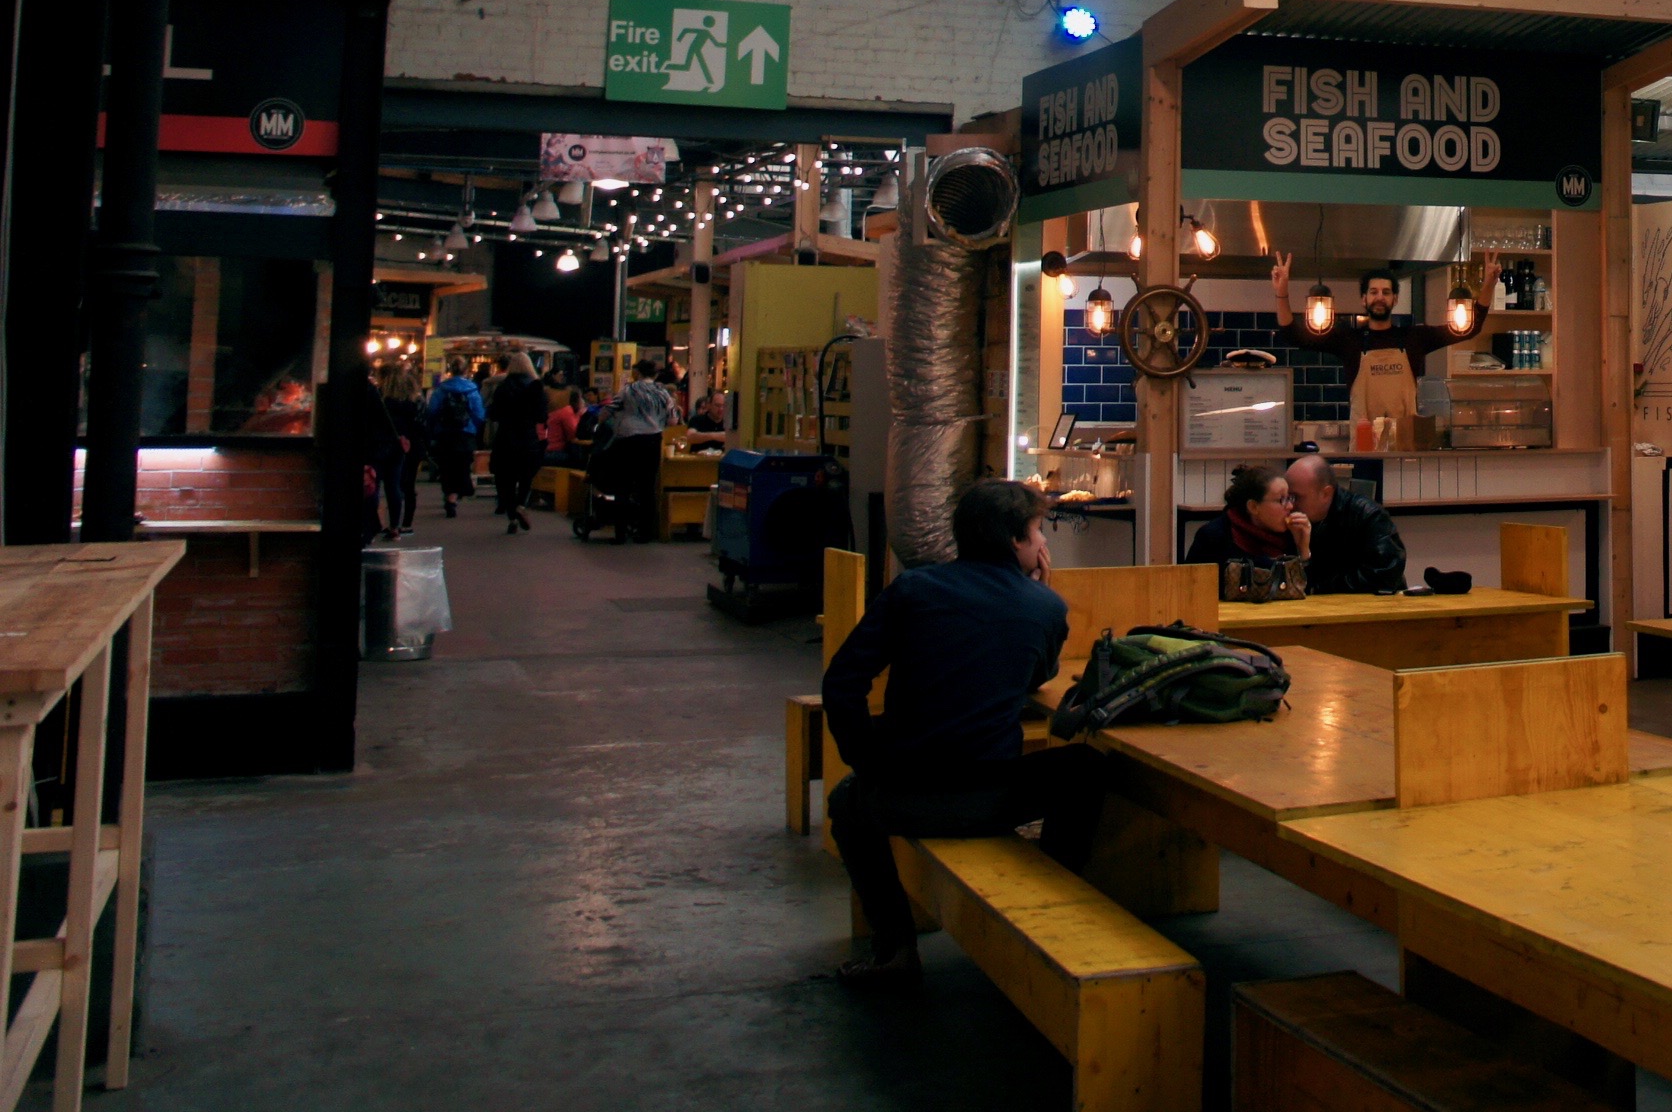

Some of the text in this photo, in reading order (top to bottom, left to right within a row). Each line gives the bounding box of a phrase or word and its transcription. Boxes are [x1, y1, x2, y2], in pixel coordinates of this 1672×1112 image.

[610, 20, 660, 45] Fire
[609, 50, 659, 73] exit
[1262, 64, 1502, 123] FISH AND
[1039, 73, 1119, 141] FISH AND
[258, 112, 295, 137] MM
[1038, 123, 1119, 187] SEAFOOD
[1263, 117, 1502, 173] SEAFOOD
[1562, 176, 1586, 196] MM
[1370, 363, 1403, 372] MERCATO
